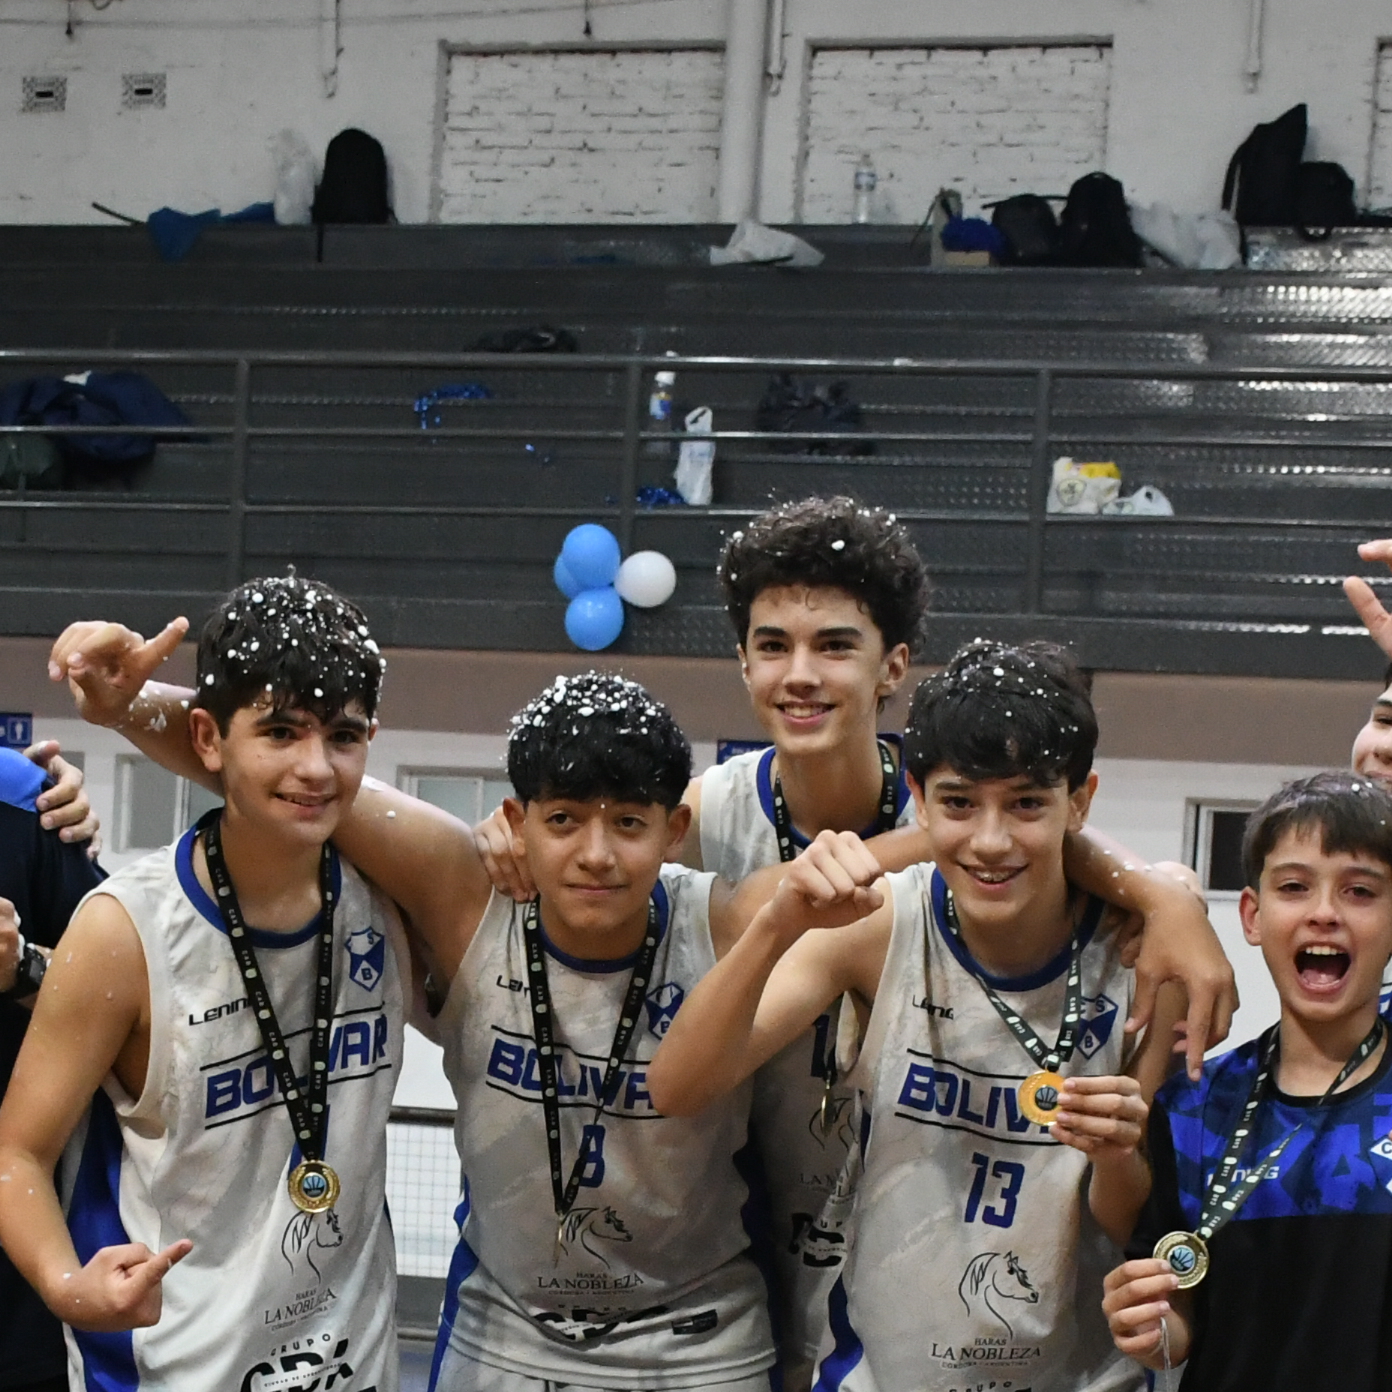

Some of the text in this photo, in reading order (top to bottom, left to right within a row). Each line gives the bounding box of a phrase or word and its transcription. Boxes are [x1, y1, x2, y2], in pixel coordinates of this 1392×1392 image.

[189, 996, 253, 1026] LENIN
[1095, 1000, 1106, 1013] S
[1084, 1034, 1094, 1049] B
[897, 1062, 1051, 1135] BOLIV
[964, 1151, 1026, 1229] 13
[537, 1276, 561, 1289] LA
[974, 1337, 1007, 1346] HARAS
[931, 1342, 1041, 1361] LA NOBLEZA
